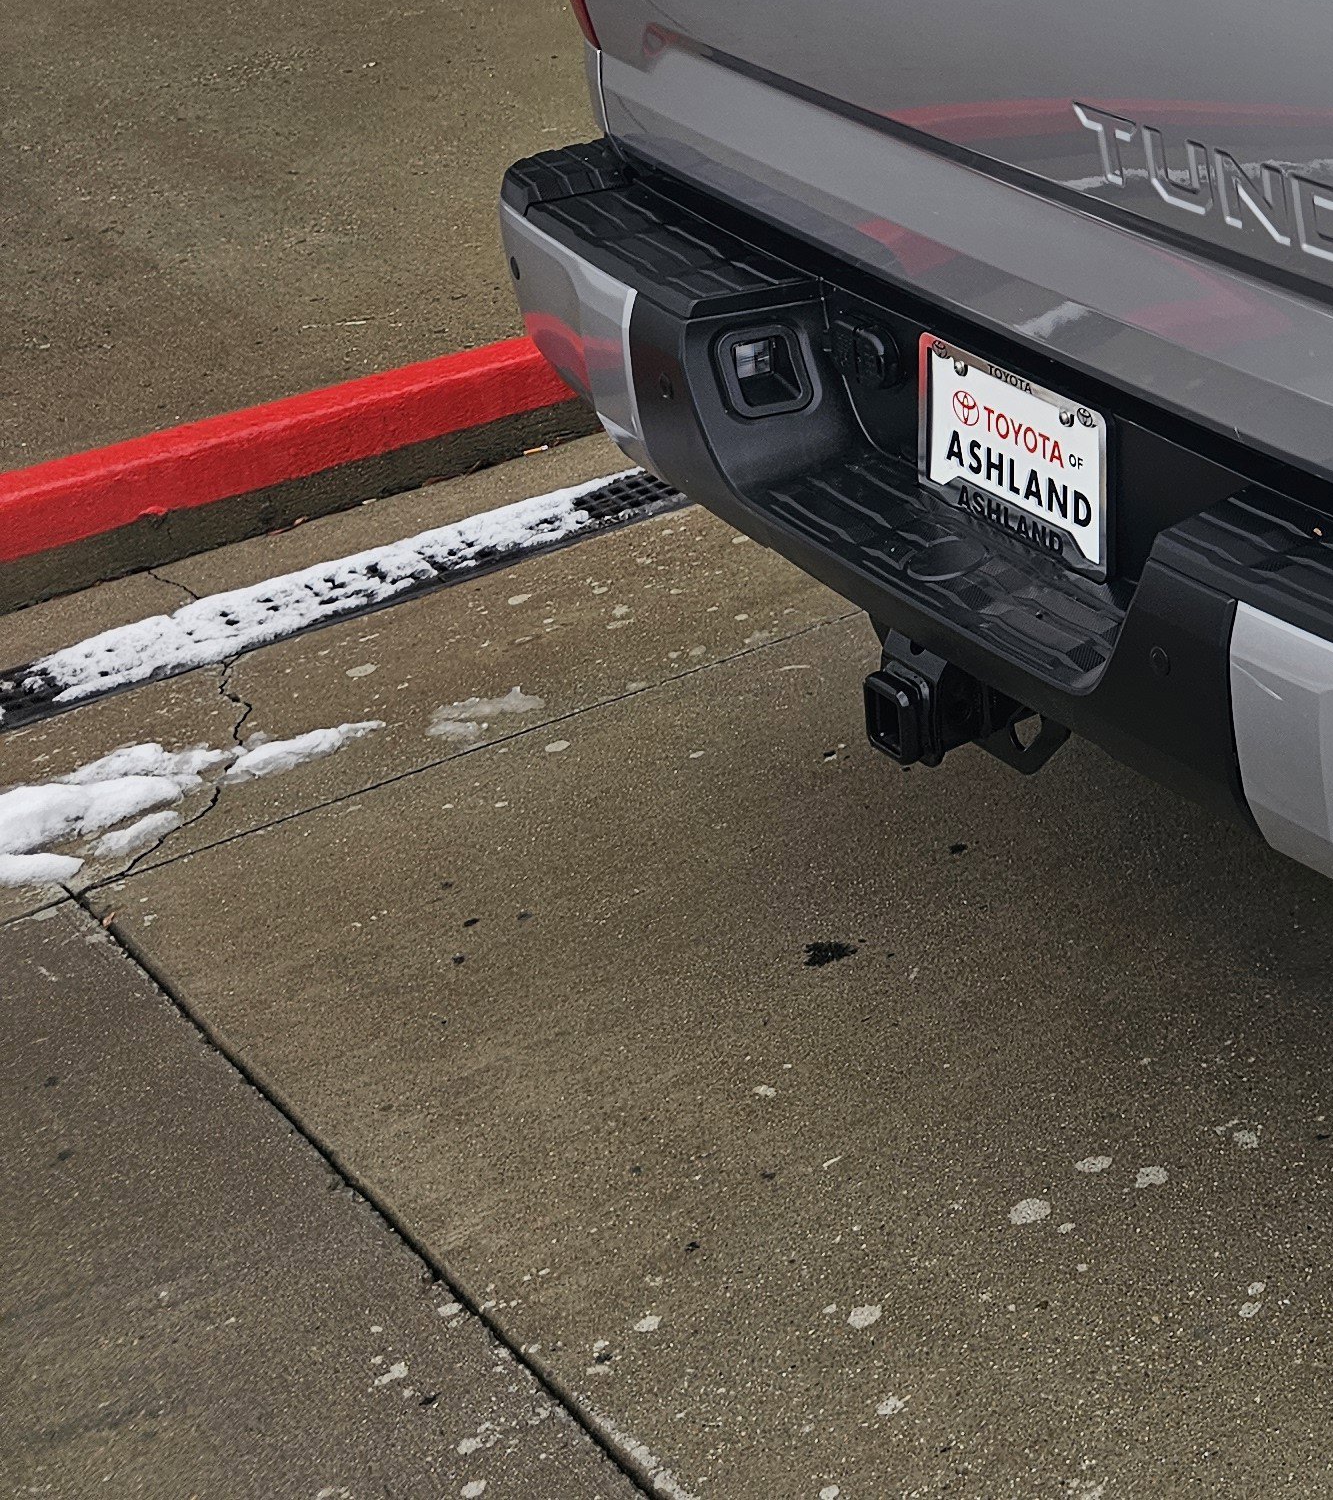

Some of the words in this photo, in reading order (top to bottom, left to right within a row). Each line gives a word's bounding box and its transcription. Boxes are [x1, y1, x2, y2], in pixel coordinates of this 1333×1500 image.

[986, 364, 1033, 395] TOYOTA
[984, 405, 1065, 469] TOYOTA
[1068, 453, 1084, 470] OF
[946, 429, 1092, 528] ASHLAND
[957, 485, 1064, 556] ASHLAND
